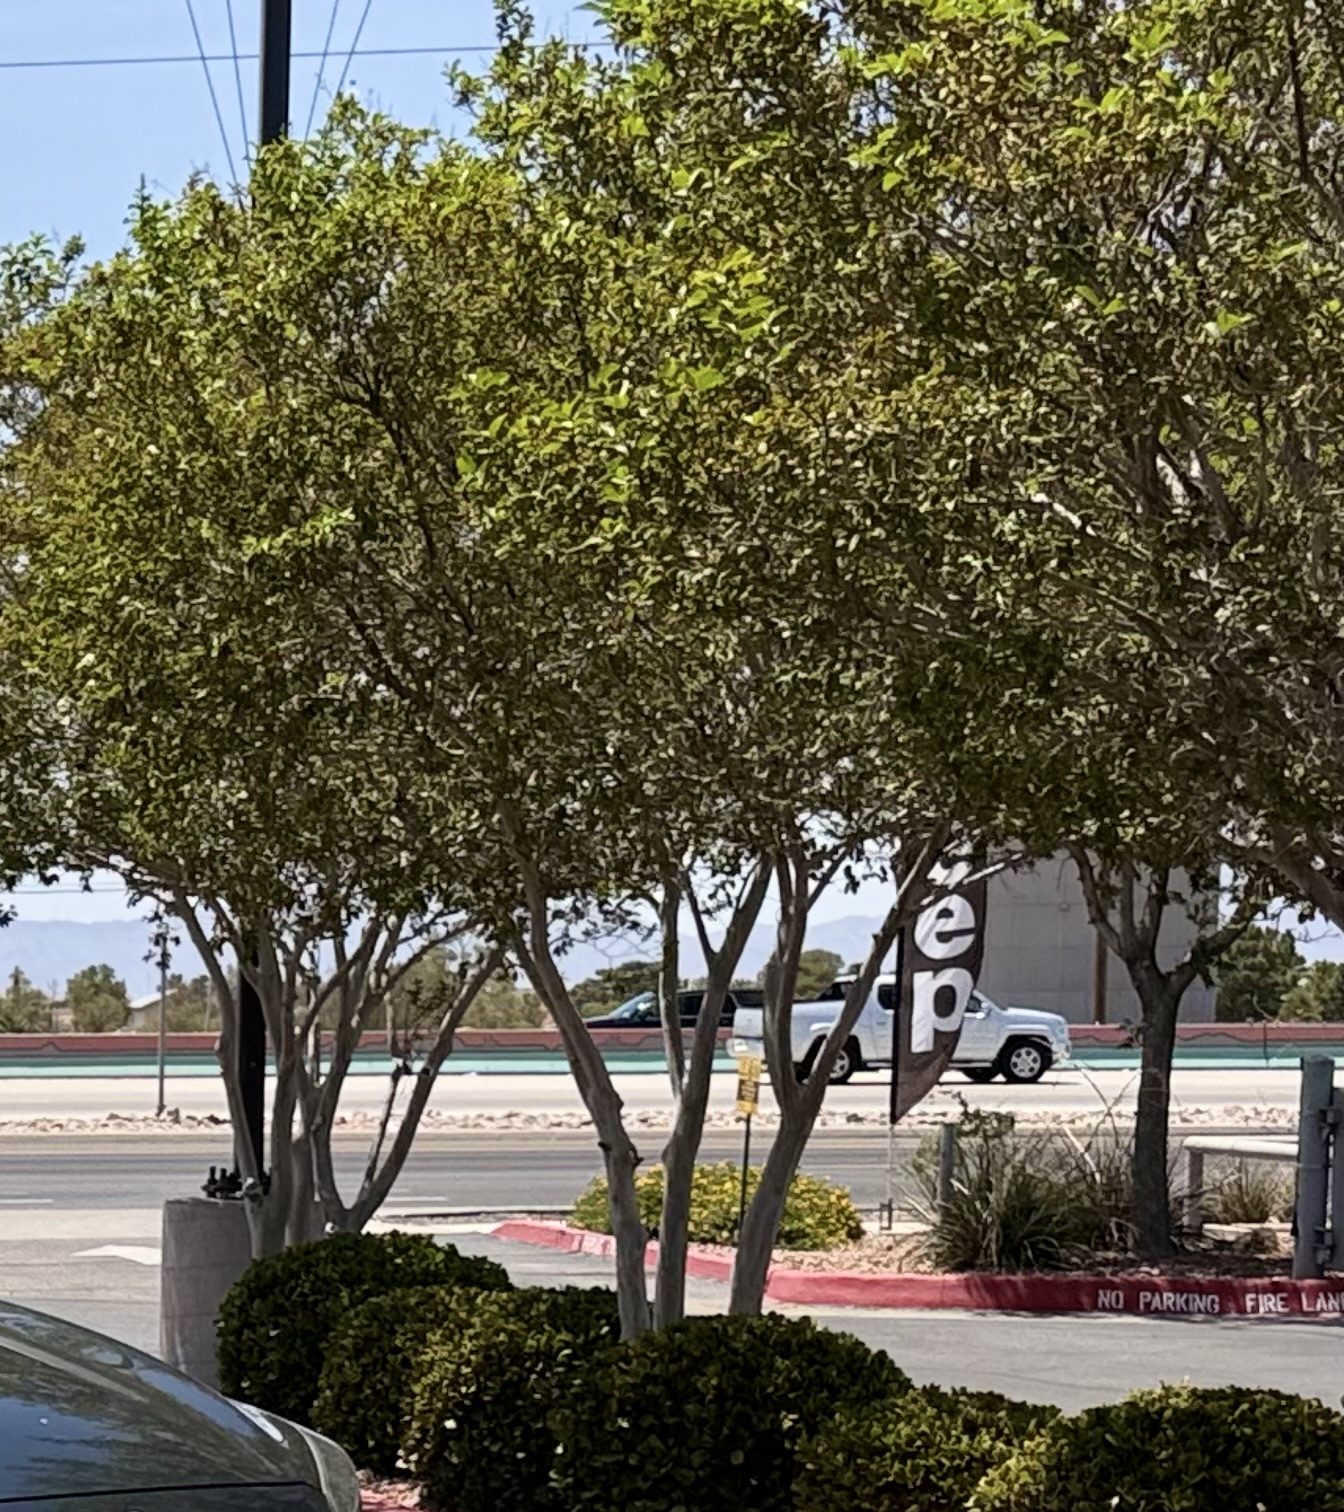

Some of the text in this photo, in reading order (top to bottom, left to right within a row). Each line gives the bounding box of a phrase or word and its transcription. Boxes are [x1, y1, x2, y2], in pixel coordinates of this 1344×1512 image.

[1097, 1289, 1124, 1309] NO
[1139, 1291, 1220, 1314] PARKING
[1245, 1292, 1290, 1314] FIRE
